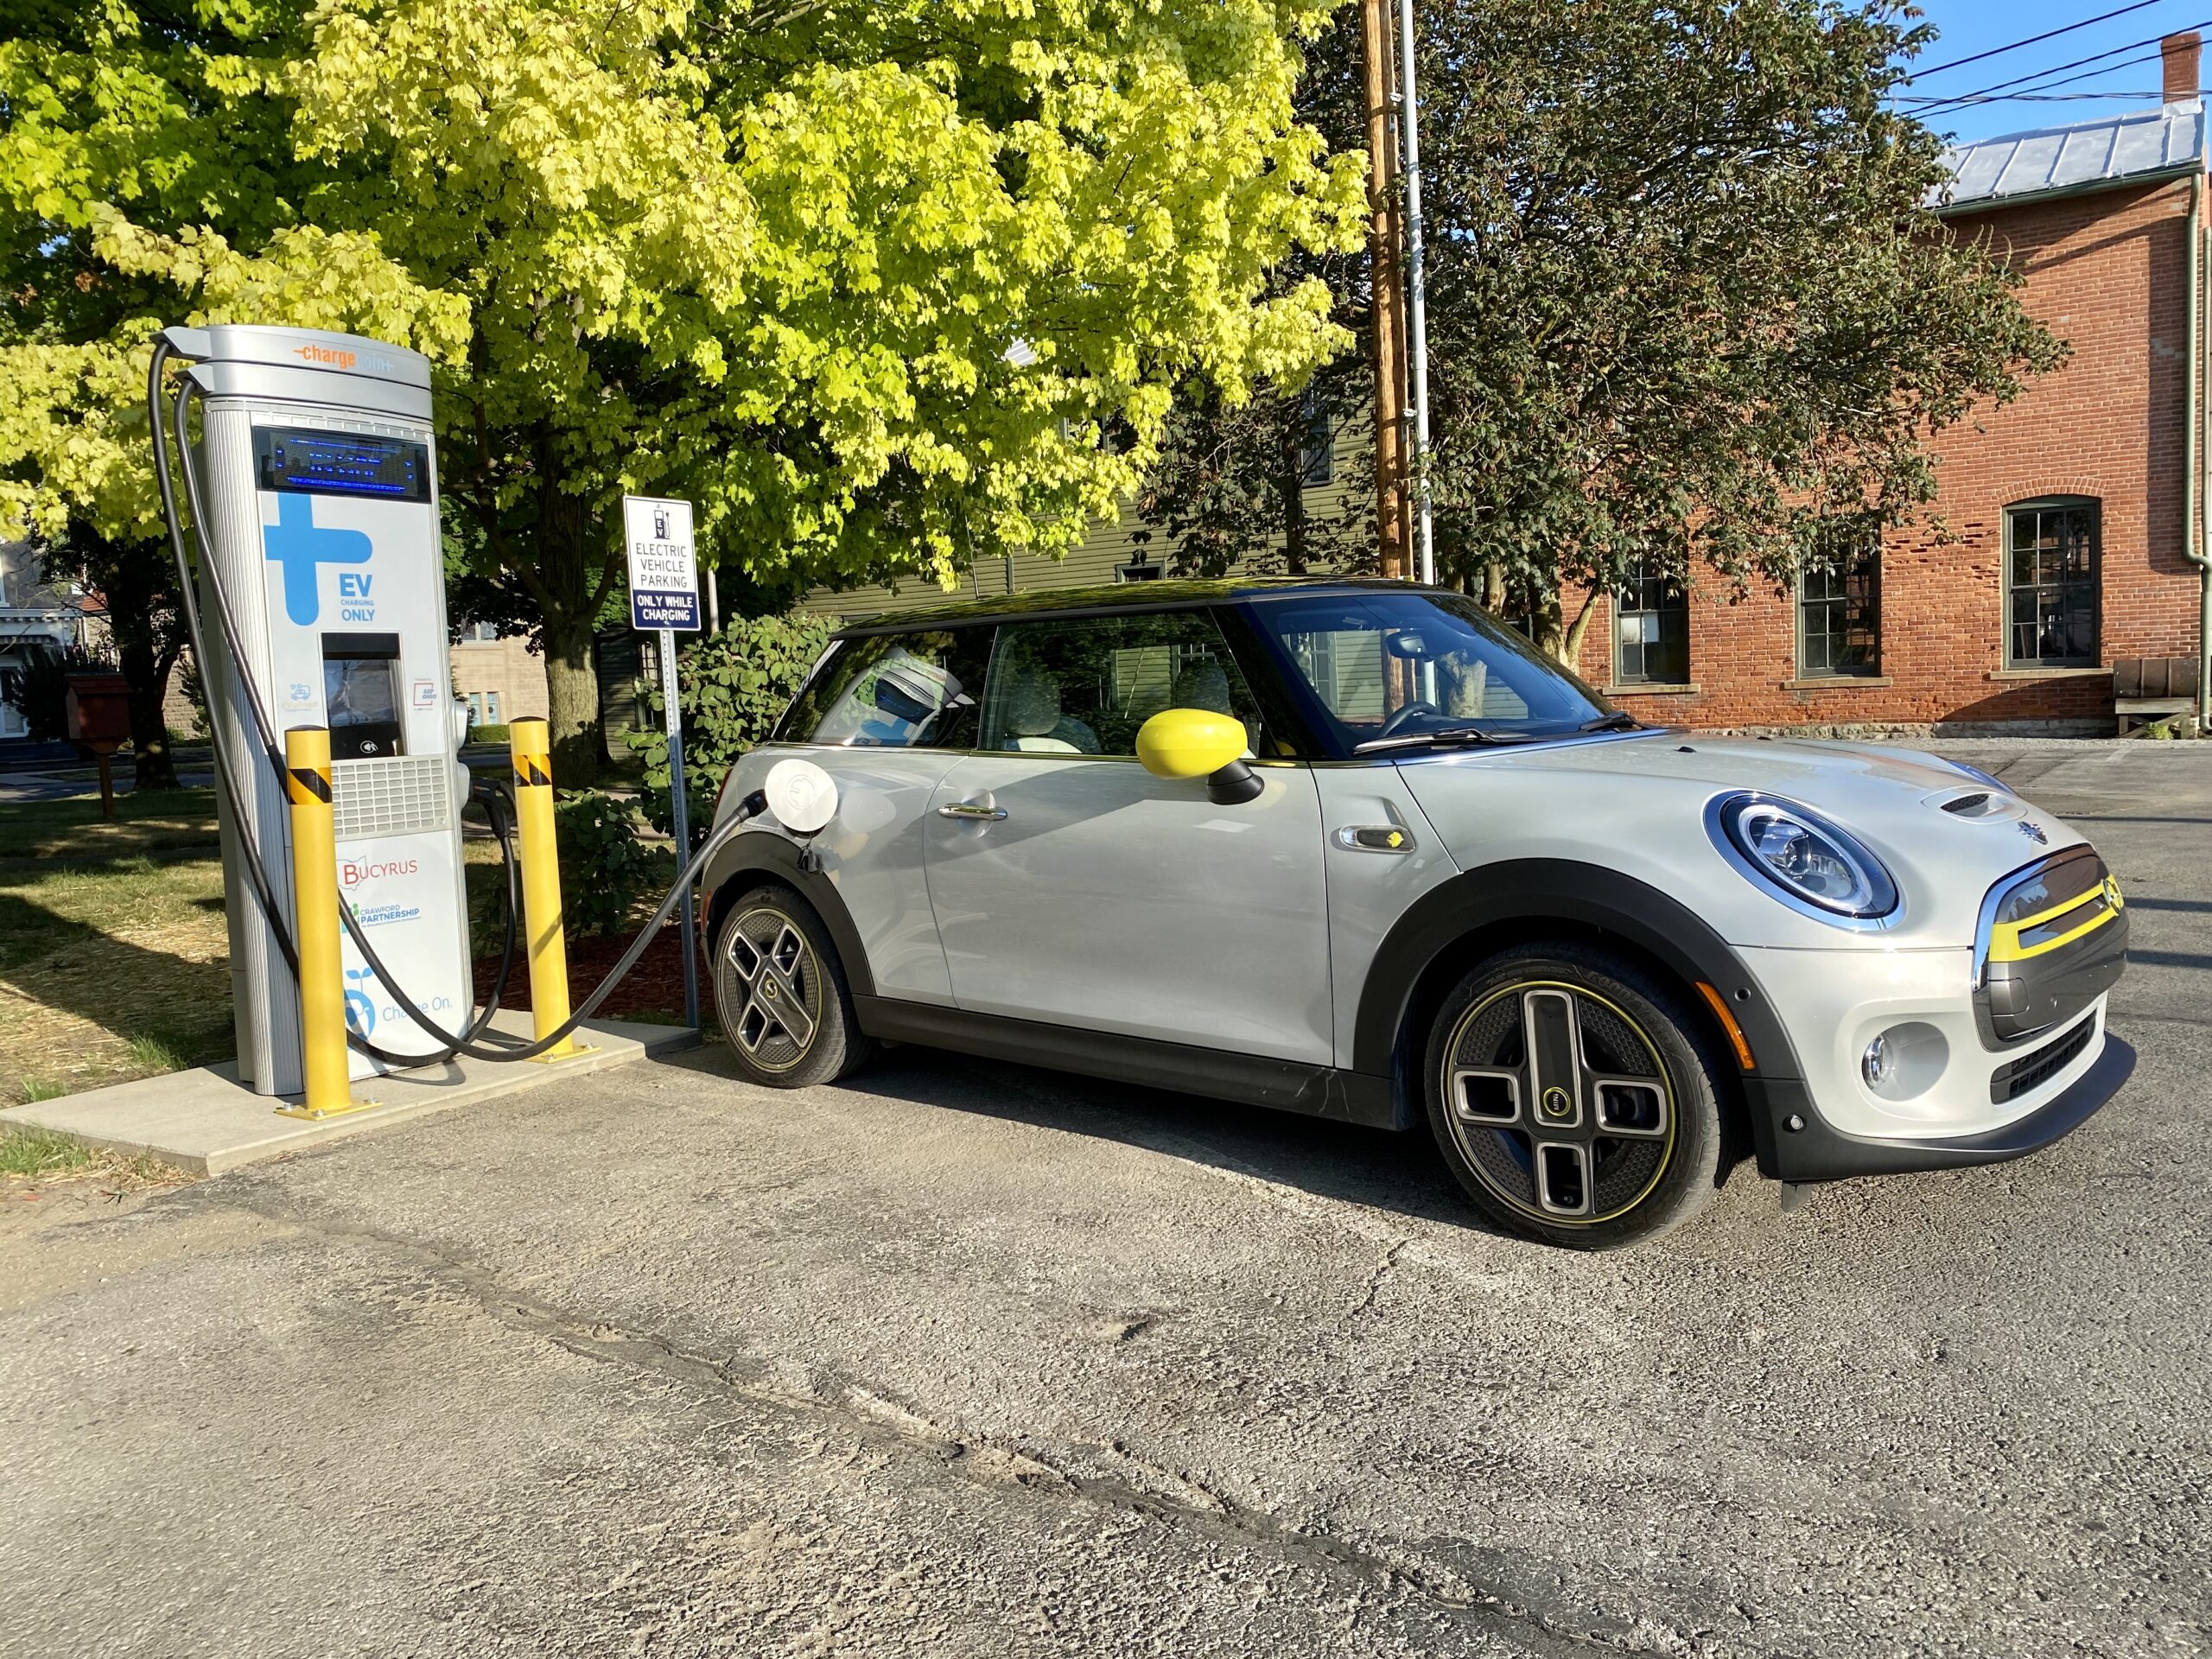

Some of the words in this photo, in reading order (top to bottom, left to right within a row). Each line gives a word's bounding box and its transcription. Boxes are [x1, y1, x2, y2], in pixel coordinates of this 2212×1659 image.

[657, 520, 664, 536] EV
[636, 543, 687, 557] ELECTRIC
[640, 558, 685, 572] VEHICLE
[340, 574, 372, 597] EV
[640, 574, 688, 588] PARKING
[637, 594, 663, 607] ONLY
[665, 595, 694, 608] WHILE
[341, 608, 375, 622] ONLY
[642, 608, 690, 621] CHARGING
[344, 861, 417, 885] BUCYRUS
[360, 904, 401, 916] CRAWFORD
[360, 908, 420, 925] PARTNERSHIP
[383, 1002, 429, 1021] Chae
